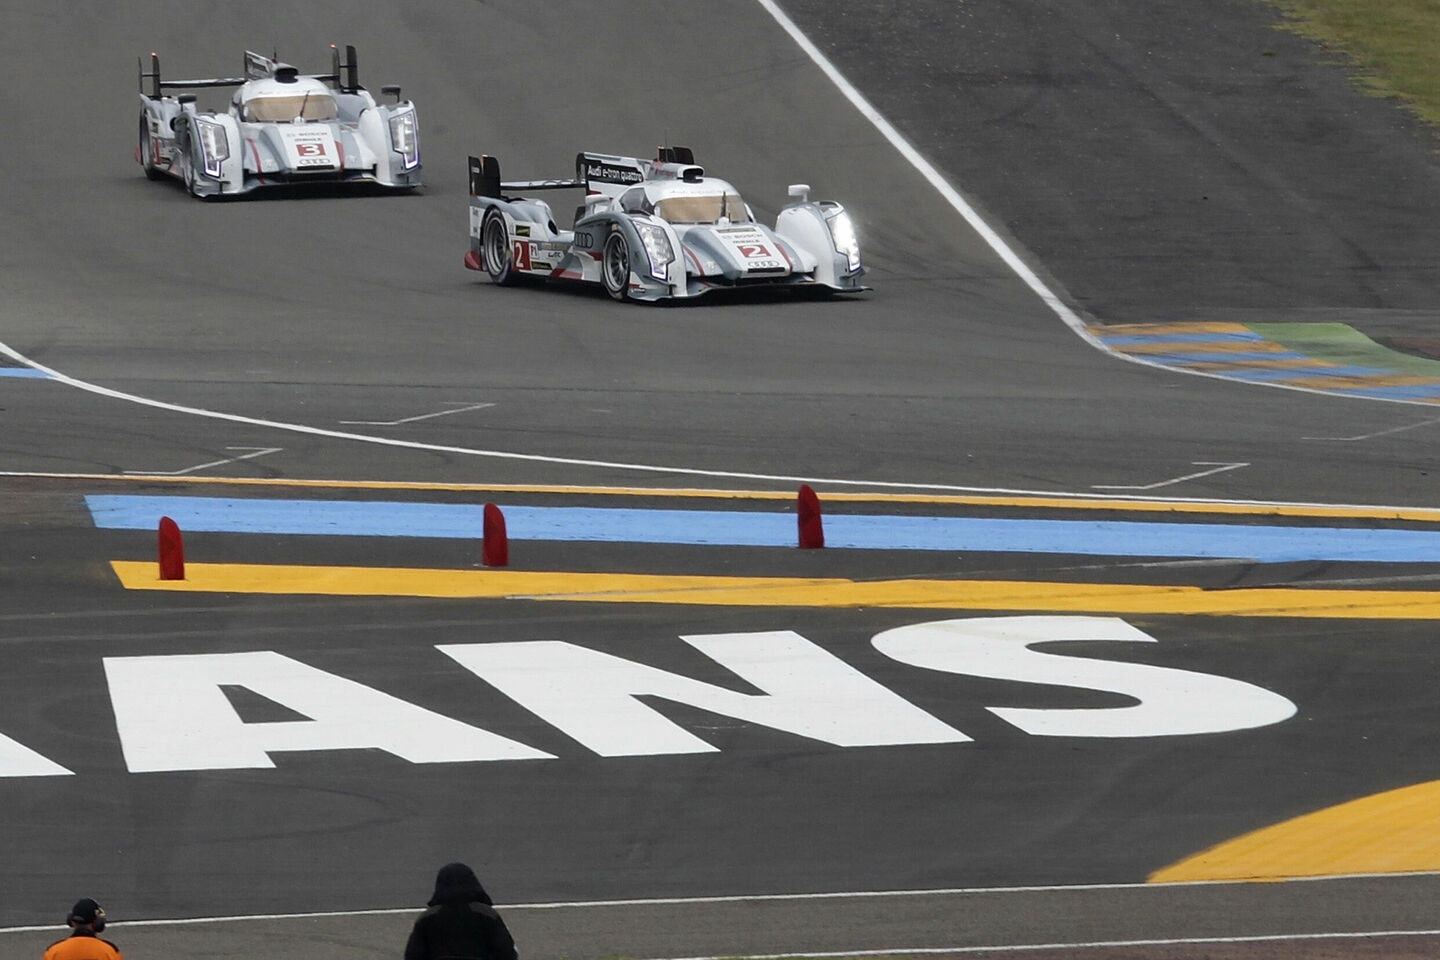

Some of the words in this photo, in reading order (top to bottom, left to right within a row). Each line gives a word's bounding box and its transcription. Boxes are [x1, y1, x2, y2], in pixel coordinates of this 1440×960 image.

[301, 144, 320, 156] 3
[587, 164, 602, 177] Audi
[602, 168, 620, 179] e-tron
[620, 171, 642, 182] quattro
[515, 242, 524, 268] 2
[742, 245, 767, 257] 2
